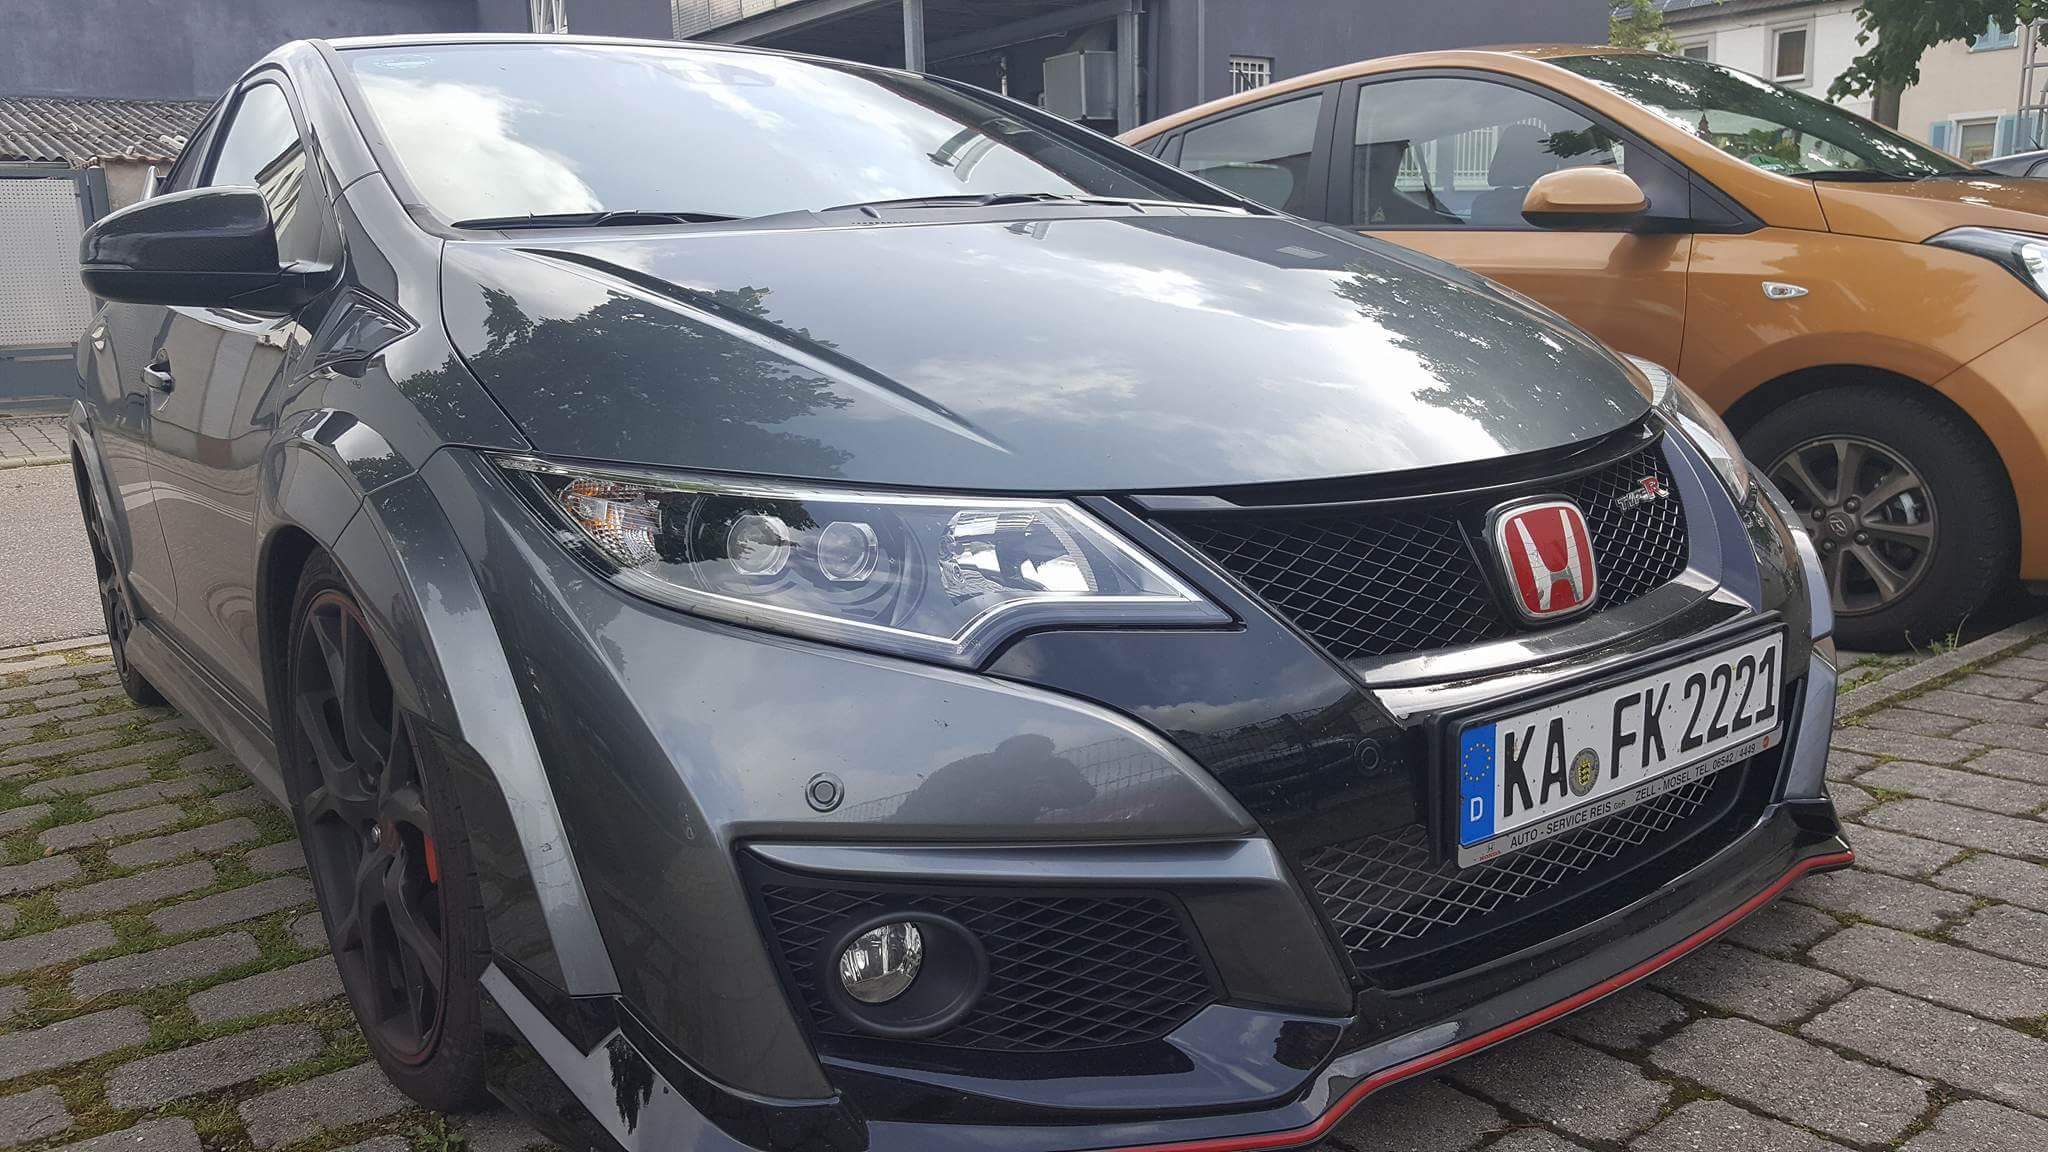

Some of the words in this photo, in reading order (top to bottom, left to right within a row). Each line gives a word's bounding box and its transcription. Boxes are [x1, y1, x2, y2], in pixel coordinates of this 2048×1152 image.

[1503, 717, 1568, 818] KA
[1610, 682, 1671, 779] FK
[1680, 646, 1775, 753] 2221
[1470, 796, 1483, 822] D
[1510, 828, 1538, 848] AUTO
[1547, 808, 1587, 833] SERVICE
[1589, 801, 1612, 817] REIS
[1635, 785, 1656, 801] ZELL
[1663, 773, 1692, 791] MOSEL
[1712, 753, 1734, 769] 06542
